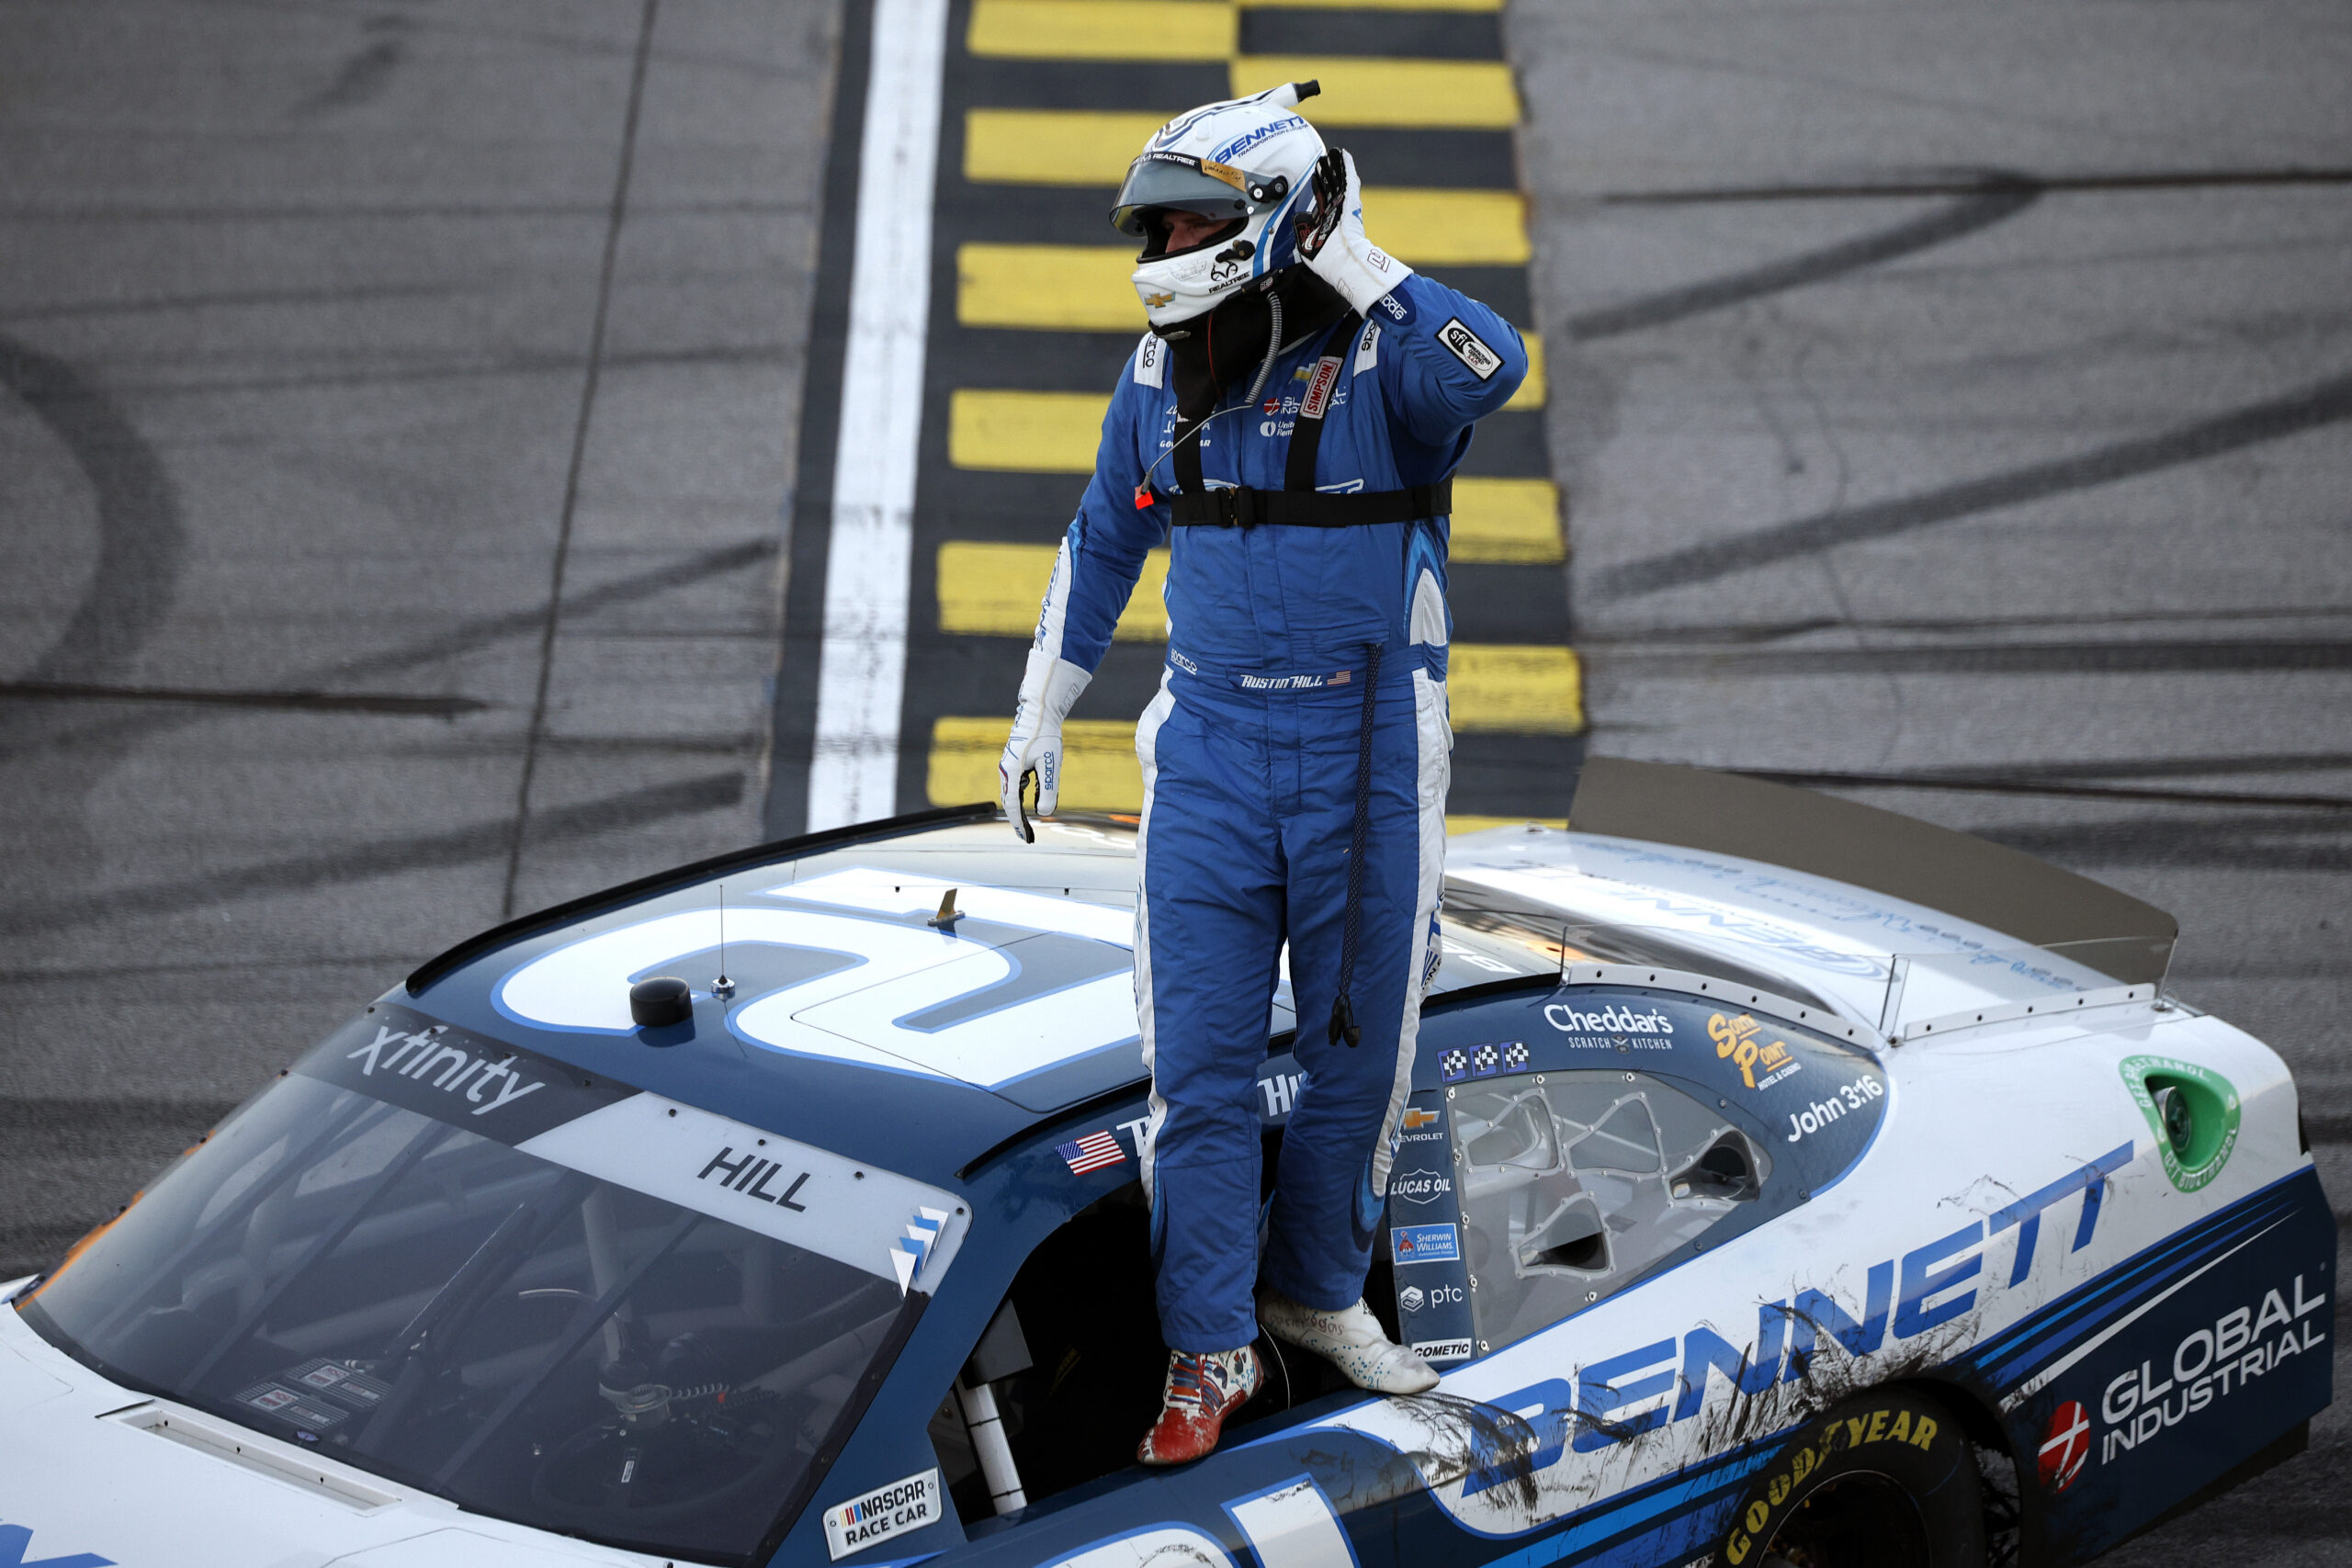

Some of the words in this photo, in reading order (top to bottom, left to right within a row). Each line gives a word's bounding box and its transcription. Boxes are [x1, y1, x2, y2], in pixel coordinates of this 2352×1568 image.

[1216, 116, 1305, 164] BENNETT
[1238, 130, 1286, 159] TRANSPORTATION
[1152, 152, 1196, 166] REALTREE
[1208, 272, 1250, 294] REALTREE
[1381, 293, 1408, 320] spa
[1451, 330, 1468, 346] sfi
[1307, 364, 1334, 412] SIMPSON
[1170, 648, 1198, 676] sparco
[1240, 674, 1290, 690] AUSTIN
[1289, 674, 1323, 689] HILL
[1044, 750, 1056, 791] sparco
[1544, 1004, 1674, 1034] Cheddar's
[1567, 1036, 1611, 1049] SCRATCH
[1631, 1037, 1673, 1050] KITCHEN
[346, 1024, 546, 1116] xfinity
[1733, 1039, 1794, 1089] POINT
[1757, 1075, 1779, 1091] HOTEL
[1781, 1062, 1802, 1078] CASINO
[1787, 1096, 1840, 1144] John
[1839, 1074, 1885, 1114] 3:16
[1398, 1132, 1444, 1144] EVROLET
[696, 1146, 812, 1213] HILL
[1391, 1179, 1430, 1195] LUCAS
[1433, 1176, 1452, 1192] OIL
[1416, 1242, 1453, 1252] WILLIAMS
[1417, 1233, 1452, 1243] SHERWIN
[1430, 1284, 1464, 1309] ptc
[1461, 1139, 2135, 1499] BENNETT
[1414, 1343, 1470, 1358] COMETIC
[2102, 1274, 2326, 1425] GLOBAL
[2101, 1319, 2326, 1466] INDUSTRIAL
[860, 1480, 926, 1520] NASCAR
[1726, 1409, 1939, 1566] GOODYEAR
[845, 1517, 890, 1546] RACE
[895, 1503, 927, 1526] CAR
